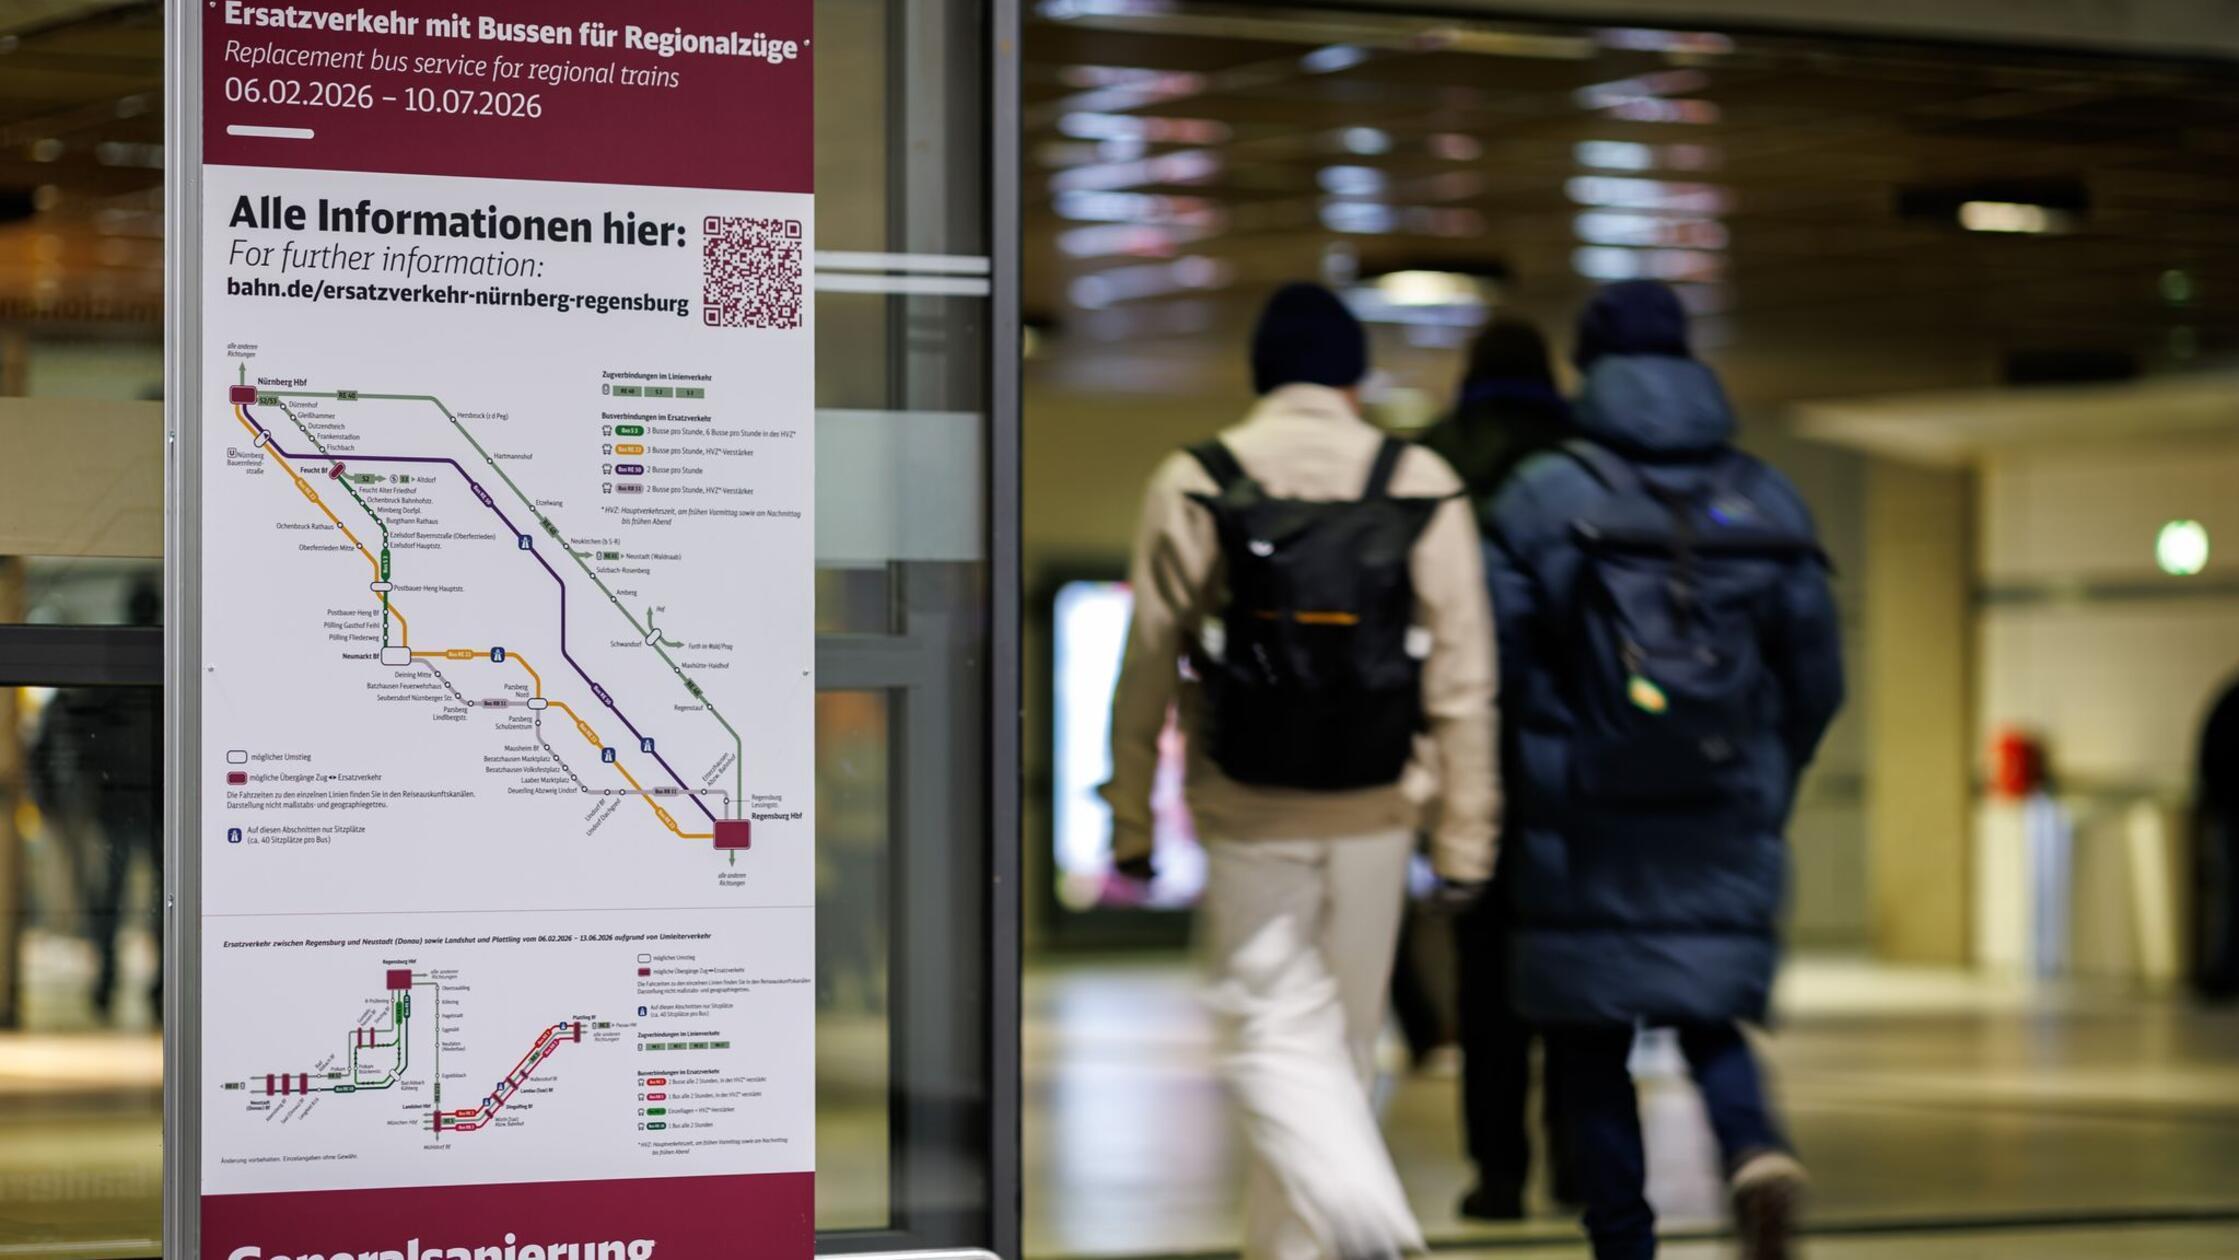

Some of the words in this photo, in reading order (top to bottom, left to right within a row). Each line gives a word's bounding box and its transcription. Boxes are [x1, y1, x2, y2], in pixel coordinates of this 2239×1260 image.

[226, 0, 419, 35] Ersatzverkehr
[426, 13, 470, 38] mit
[479, 16, 572, 44] Bussen
[579, 22, 618, 47] für
[625, 25, 798, 64] Regionalzüge
[225, 40, 365, 69] Replacement
[371, 48, 408, 71] bus
[413, 55, 487, 76] service
[493, 56, 523, 81] for
[528, 61, 615, 85] regional
[621, 66, 679, 87] trains
[226, 77, 373, 108] 06.02.2026
[405, 88, 541, 117] 10.07.2026
[229, 195, 306, 230] Alle
[319, 198, 592, 243] Informationen
[604, 211, 685, 247] hier:
[230, 239, 274, 266] For
[282, 241, 375, 273] further
[383, 246, 543, 278] information:
[227, 277, 689, 316] bahn.de/ersatzverkehr-nürnberg-regensburg
[602, 371, 658, 381] Zugverbindungen
[668, 373, 712, 381] Linienverkehr
[258, 377, 292, 387] Nürnberg
[294, 379, 307, 387] Hbf
[602, 412, 657, 422] Busverbindungen
[667, 414, 711, 422] Ersatzverkehr
[682, 427, 705, 436] Stunde,
[741, 429, 762, 437] Stunde
[652, 446, 669, 454] Busse
[682, 447, 704, 456] Stunde,
[682, 466, 703, 474] Stunde
[652, 485, 669, 493] Busse
[682, 486, 705, 495] Stunde,
[394, 585, 438, 593] Postbauer-Heng
[616, 589, 637, 597] Amberg
[329, 634, 348, 642] Pölling
[251, 753, 283, 762] möglicher
[284, 753, 311, 762] Umstieg
[249, 774, 279, 783] mögliche
[280, 772, 315, 782] Übergänge
[316, 773, 329, 782] Zug
[227, 801, 264, 810] Darstellung
[752, 813, 789, 821] Regensburg
[791, 812, 802, 820] Hbf
[282, 826, 321, 834] Abschnitten
[334, 826, 365, 834] Sitzplätze
[271, 836, 303, 844] Sitzplätze
[316, 836, 331, 844] Bus)
[224, 940, 271, 948] Ersatzverkehr
[305, 939, 346, 948] Regensburg
[395, 938, 422, 946] (Donau)
[445, 936, 476, 944] Landshut
[477, 936, 490, 944] und
[492, 935, 521, 945] Plattling
[538, 935, 572, 943] 06.02.2026
[580, 934, 613, 942] 13.06.2026
[615, 934, 645, 943] aufgrund
[660, 933, 712, 941] Umleiterverkehr
[228, 1233, 655, 1260] lnierung
